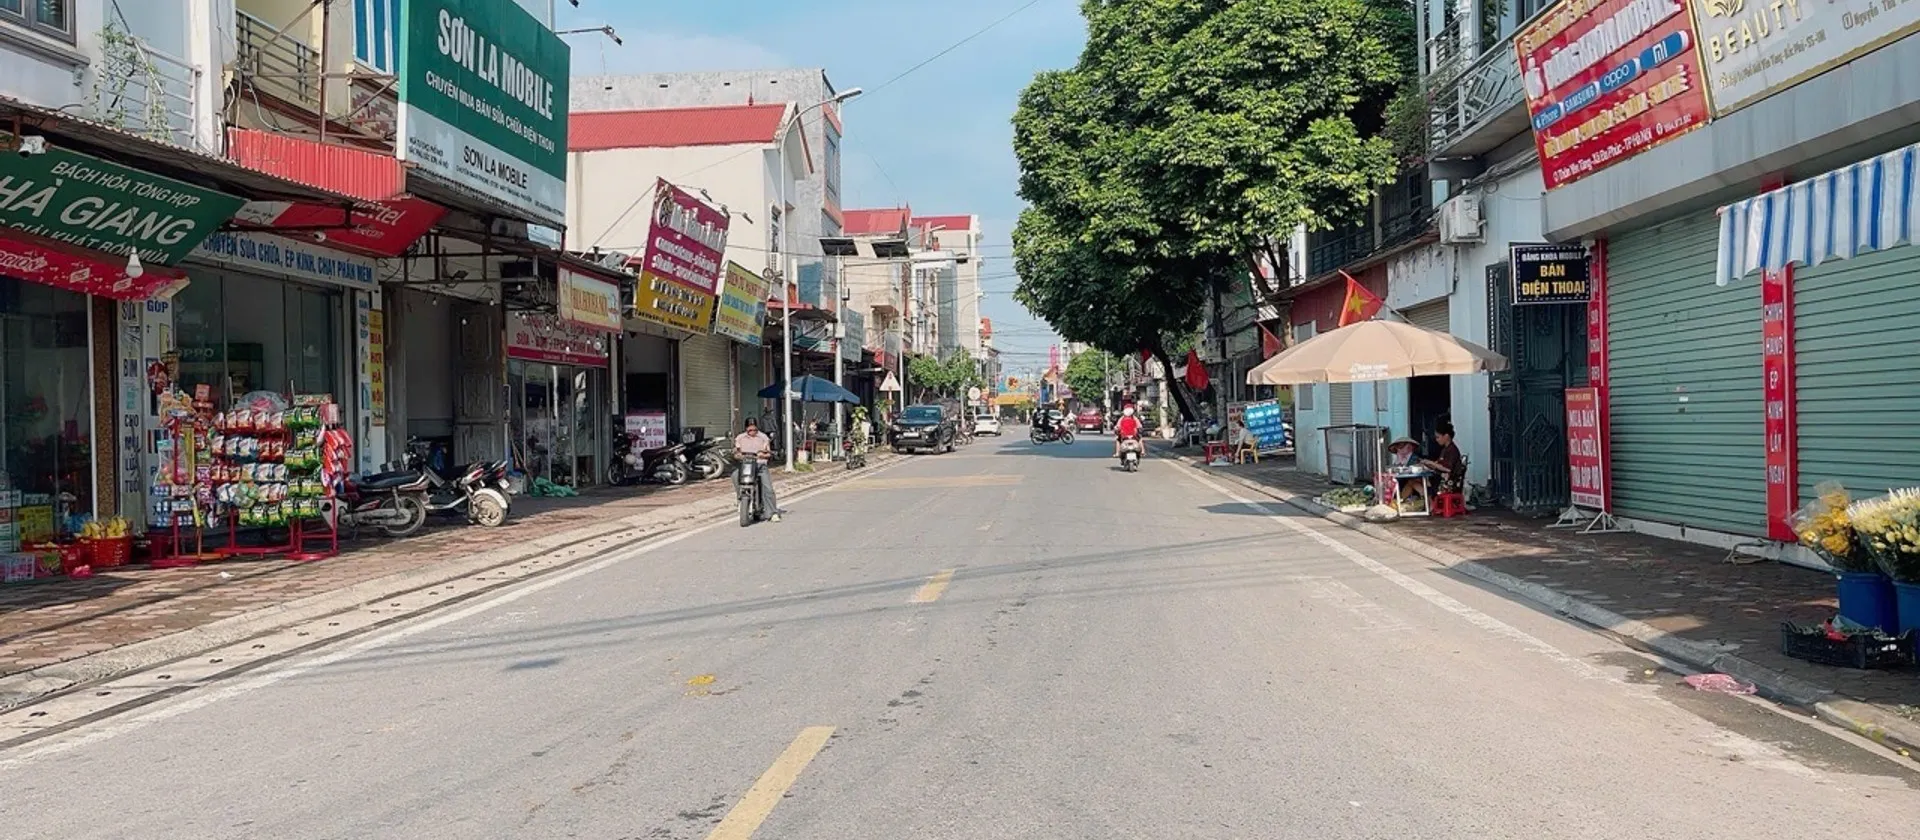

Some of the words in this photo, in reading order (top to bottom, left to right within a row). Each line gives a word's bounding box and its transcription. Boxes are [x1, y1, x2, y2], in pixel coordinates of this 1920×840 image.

[438, 8, 475, 72] SƠN
[478, 36, 499, 88] LA
[501, 51, 553, 121] MOBILE
[426, 70, 459, 98] CHUYÊN
[458, 89, 475, 110] MUA
[475, 96, 491, 119] BÁN
[1564, 85, 1596, 111] SAMSUNG
[50, 161, 101, 185] BÁCH
[98, 173, 128, 193] HÓA
[167, 191, 201, 209] HỢP
[463, 144, 484, 172] SƠN
[485, 159, 498, 178] LA
[498, 164, 528, 190] MOBILE
[60, 196, 195, 246] GIANG
[1540, 251, 1558, 261] KHOA
[1540, 262, 1565, 277] BÁN
[1522, 280, 1549, 299] ĐIỆN
[1551, 280, 1585, 297] THOẠI
[1581, 404, 1596, 428] BÁN
